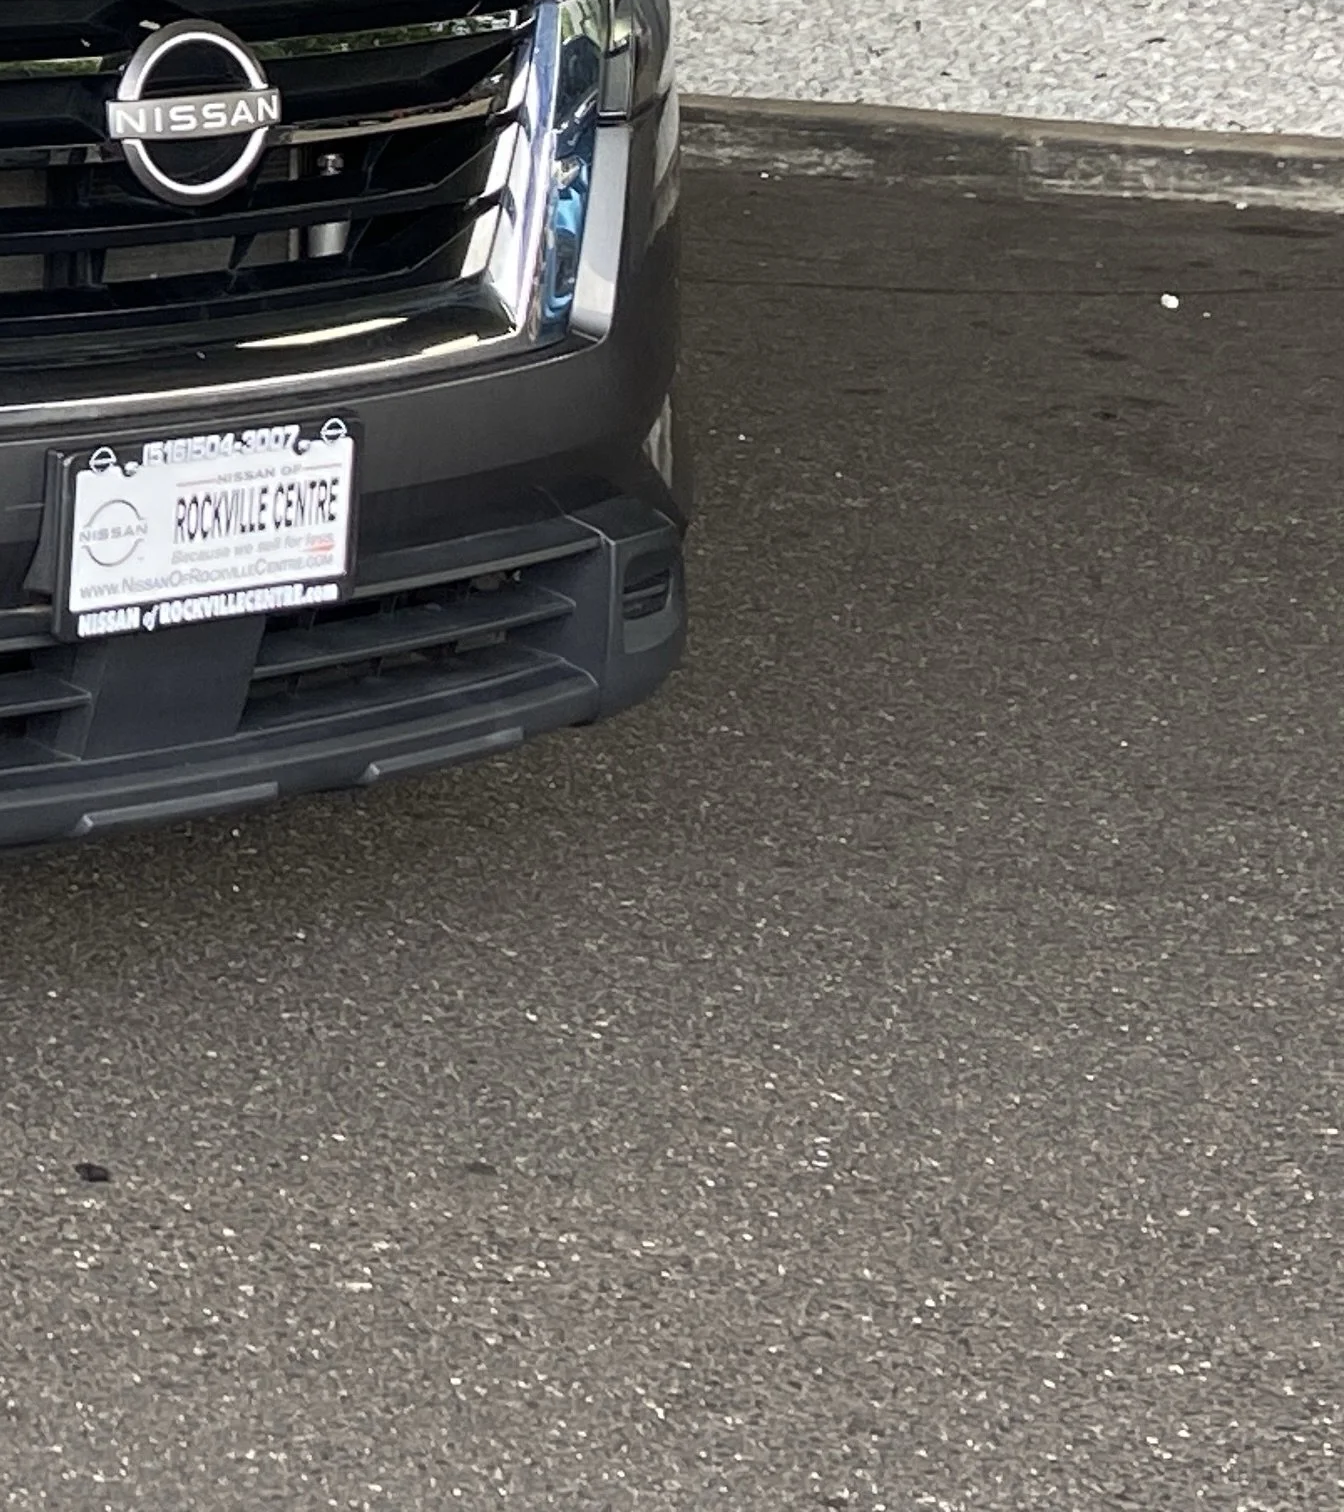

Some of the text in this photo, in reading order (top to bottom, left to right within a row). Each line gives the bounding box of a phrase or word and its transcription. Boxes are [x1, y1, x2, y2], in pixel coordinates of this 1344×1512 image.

[115, 94, 278, 134] NISSAN
[216, 466, 275, 483] NISSAN
[173, 476, 341, 544] ROCKVILLE CENTRE
[79, 522, 148, 543] NISSAN
[77, 606, 141, 638] NISSAN
